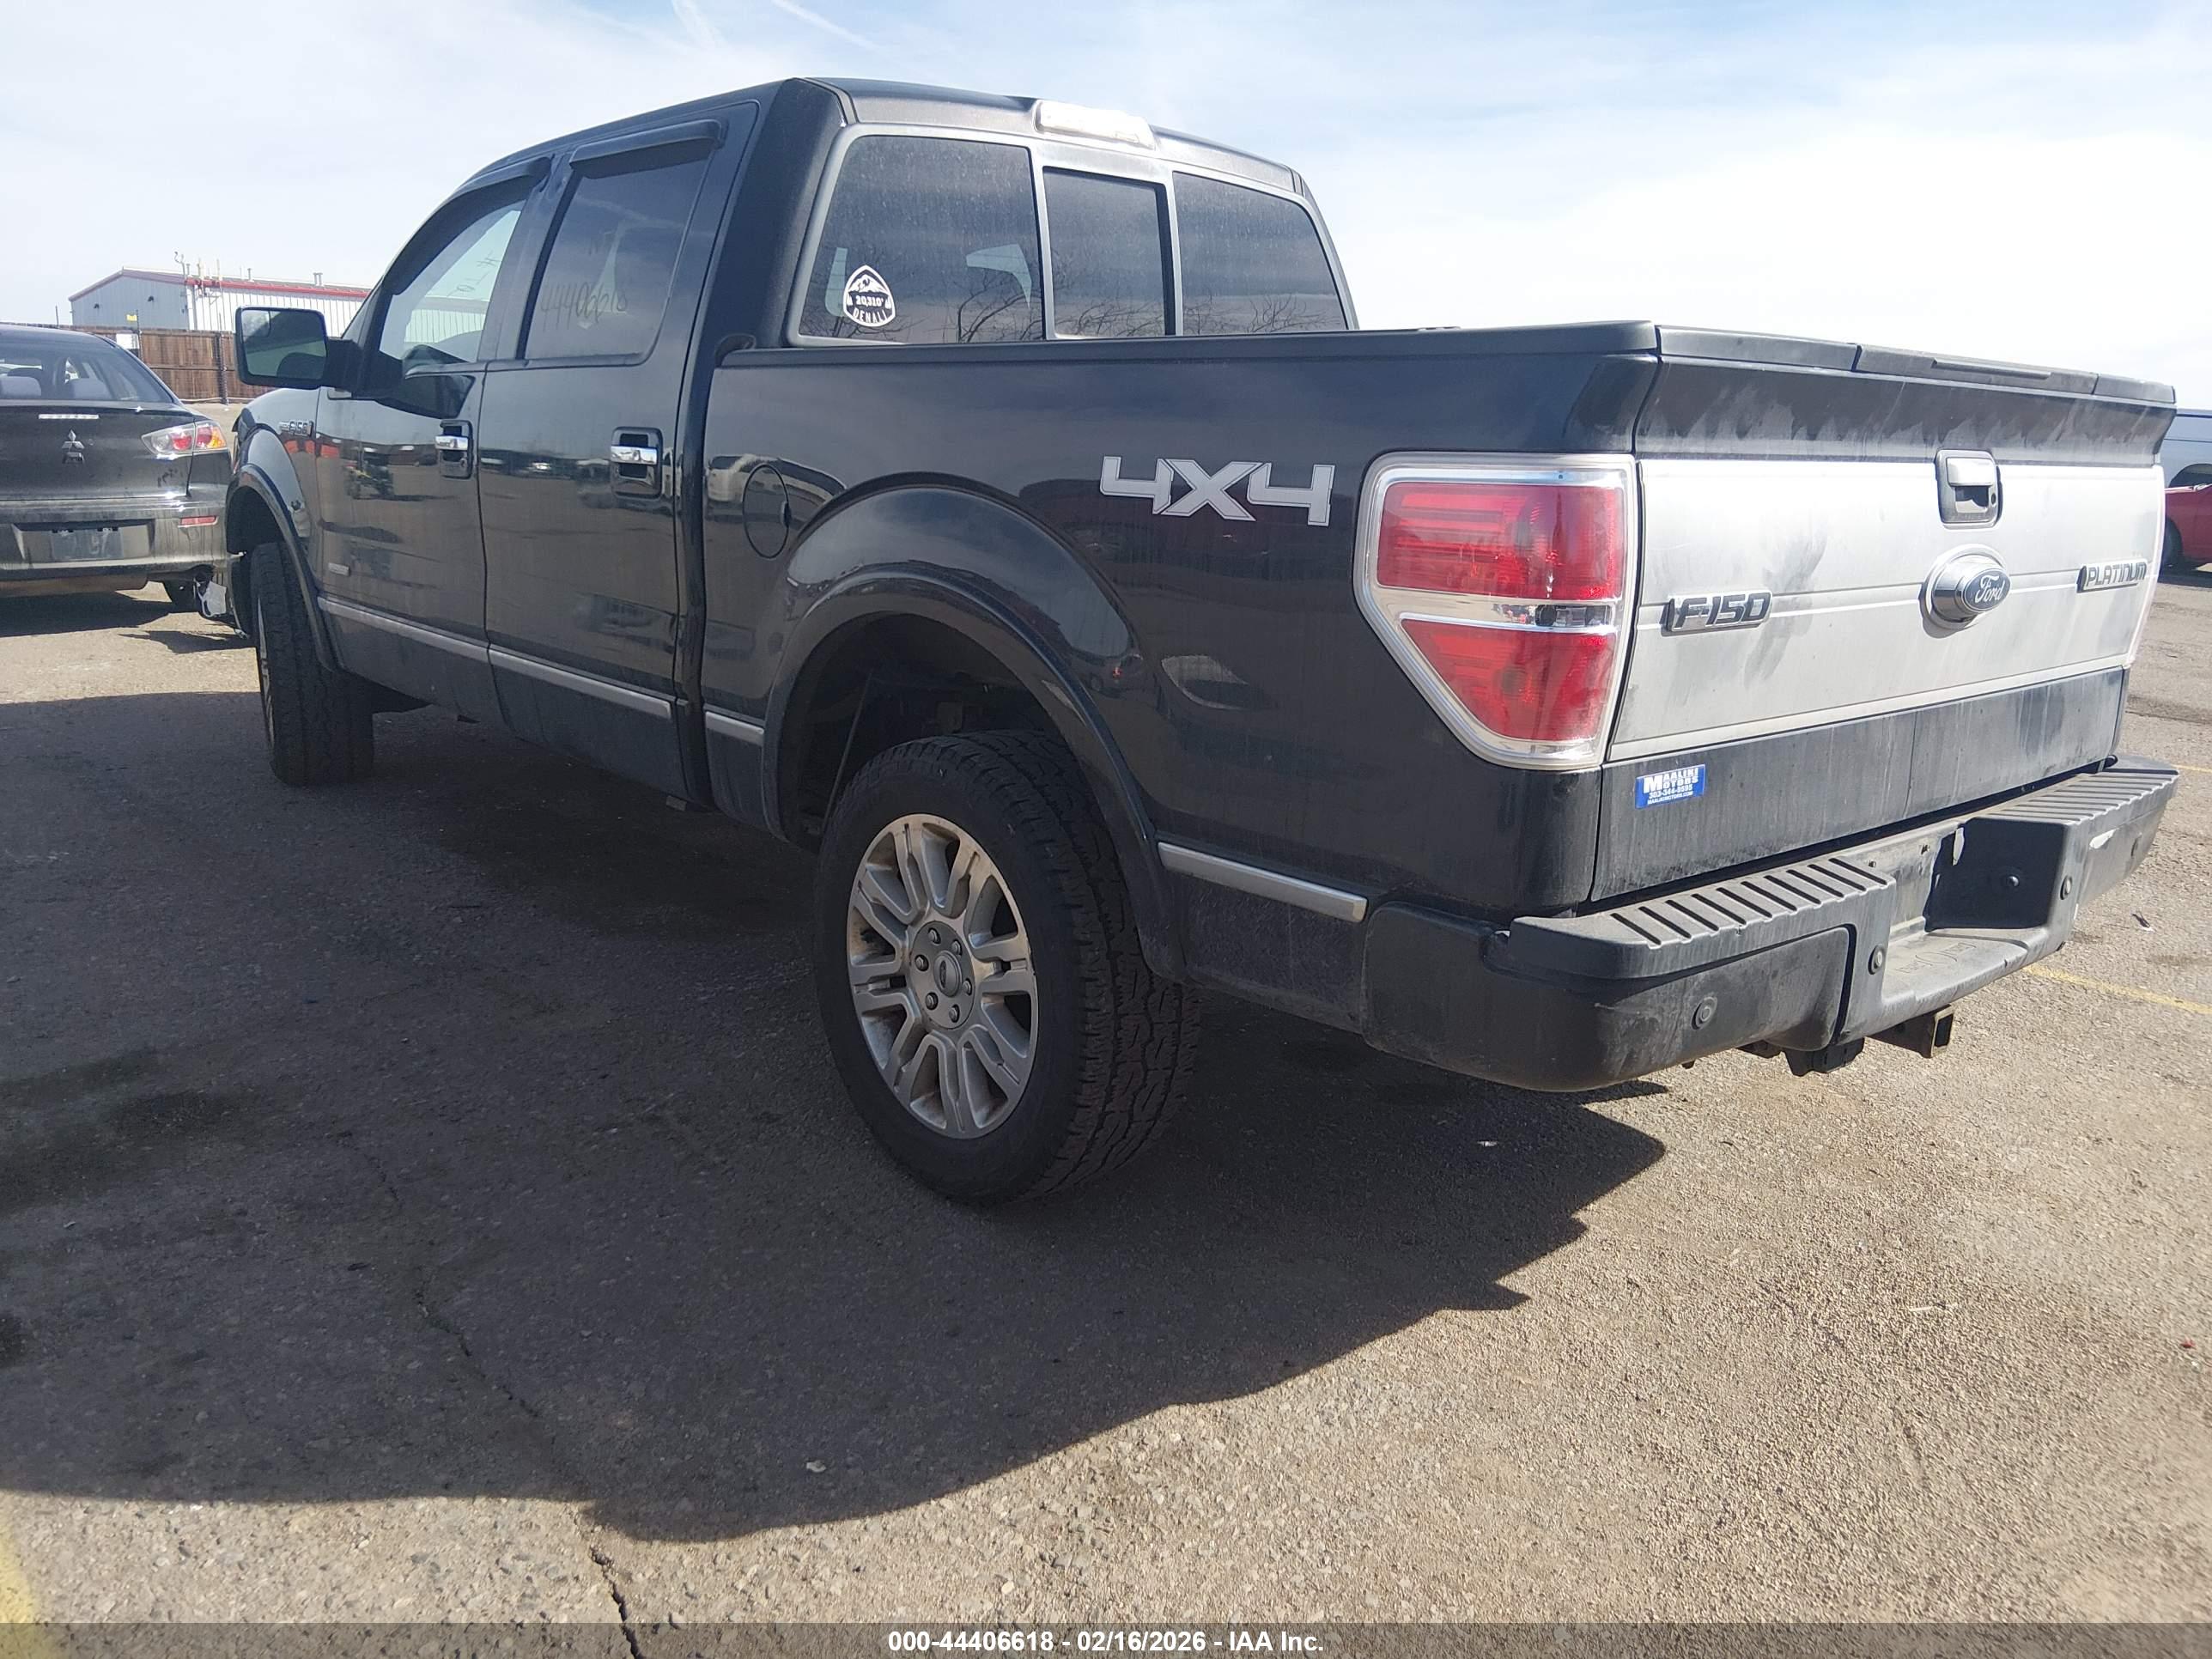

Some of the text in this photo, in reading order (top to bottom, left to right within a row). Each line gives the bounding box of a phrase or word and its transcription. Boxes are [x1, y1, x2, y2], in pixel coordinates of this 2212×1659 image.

[853, 307, 888, 323] DENALI
[2087, 562, 2147, 586] PLATINUM
[1974, 574, 2005, 602] Ford
